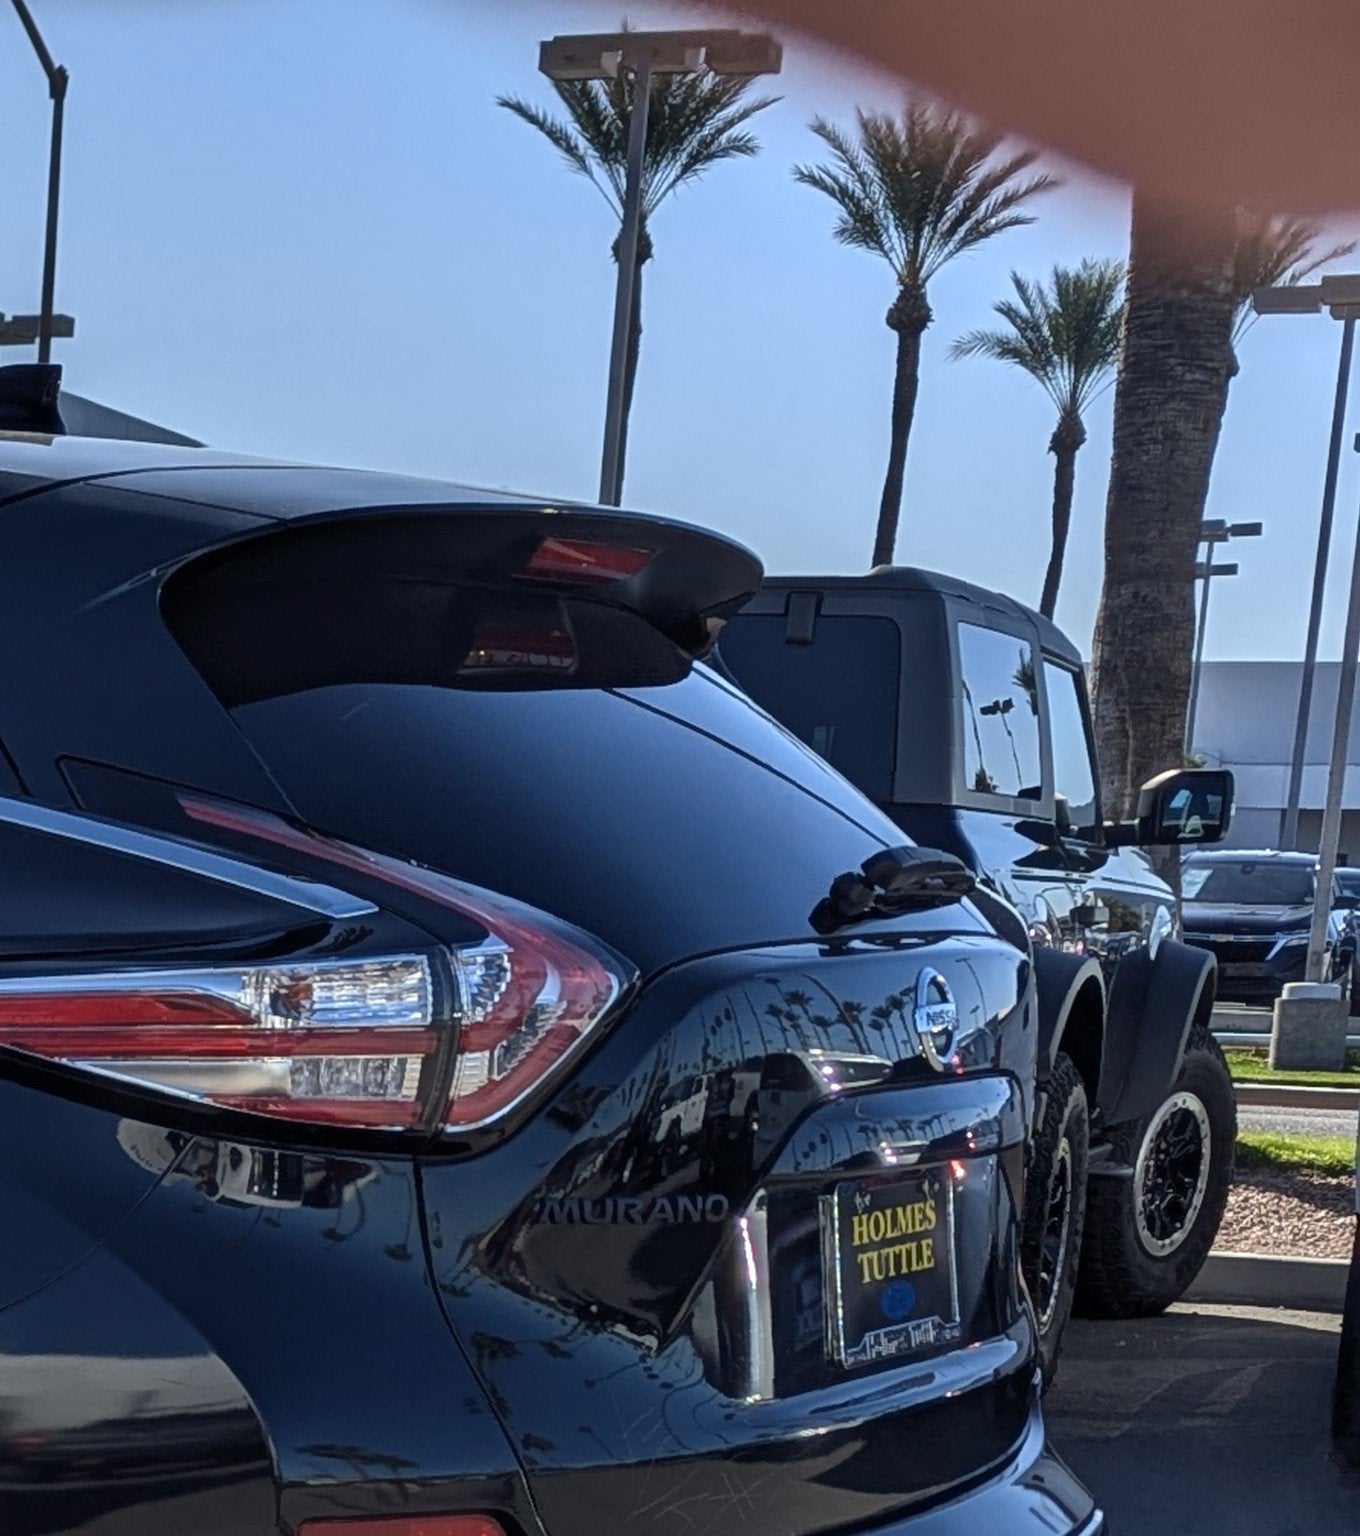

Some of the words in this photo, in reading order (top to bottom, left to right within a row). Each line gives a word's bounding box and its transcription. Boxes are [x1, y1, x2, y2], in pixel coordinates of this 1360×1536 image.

[541, 1194, 729, 1226] MURANO
[852, 1201, 937, 1245] HOLMES
[858, 1239, 935, 1283] TUTTLE
